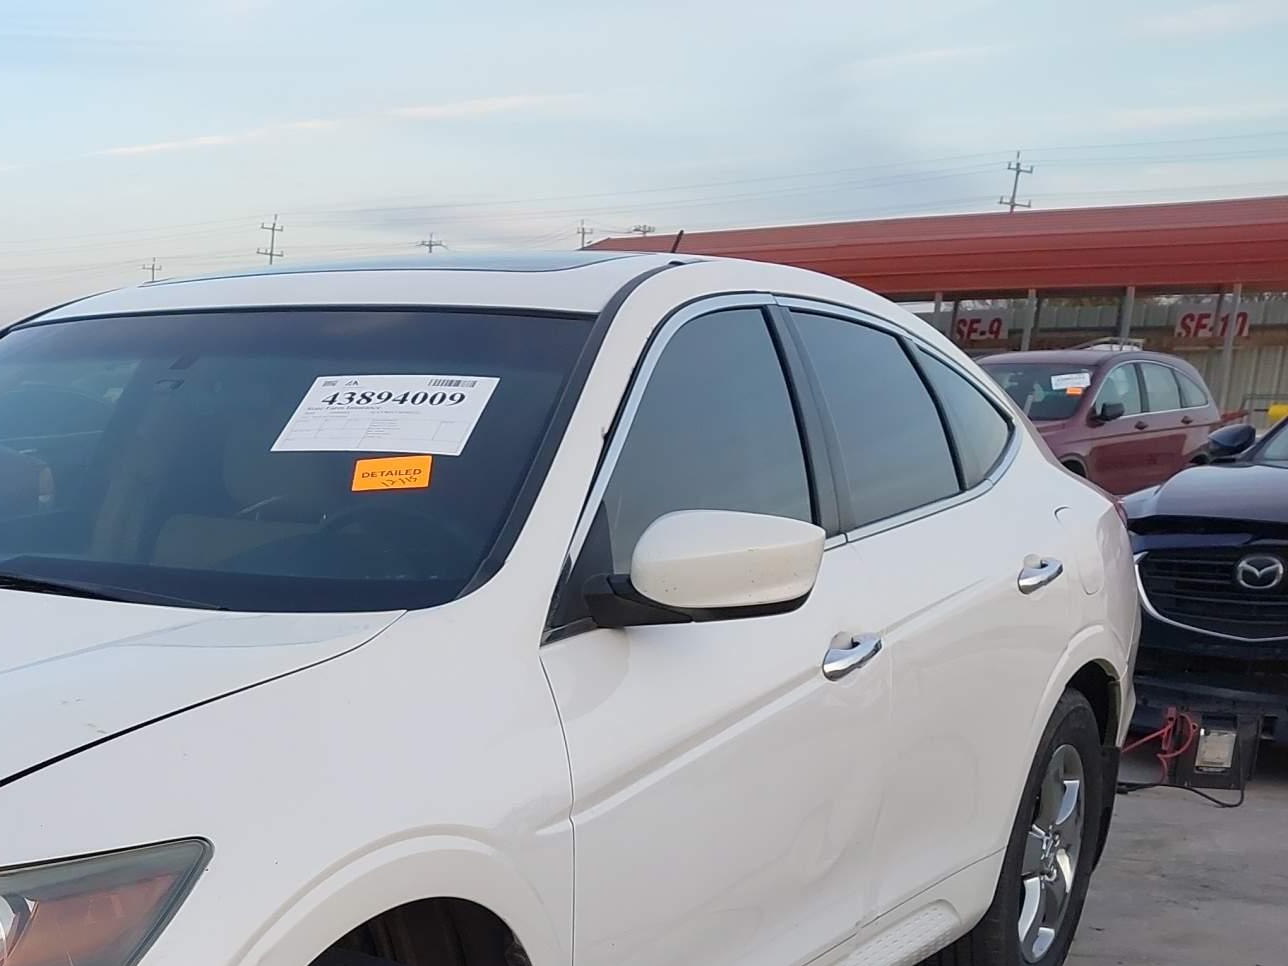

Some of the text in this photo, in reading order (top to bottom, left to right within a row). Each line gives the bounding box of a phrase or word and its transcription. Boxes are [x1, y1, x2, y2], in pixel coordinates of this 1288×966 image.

[956, 317, 1002, 339] SF-9
[1177, 311, 1248, 337] SF-10
[320, 390, 467, 407] 43894009
[361, 468, 422, 479] DETAILED
